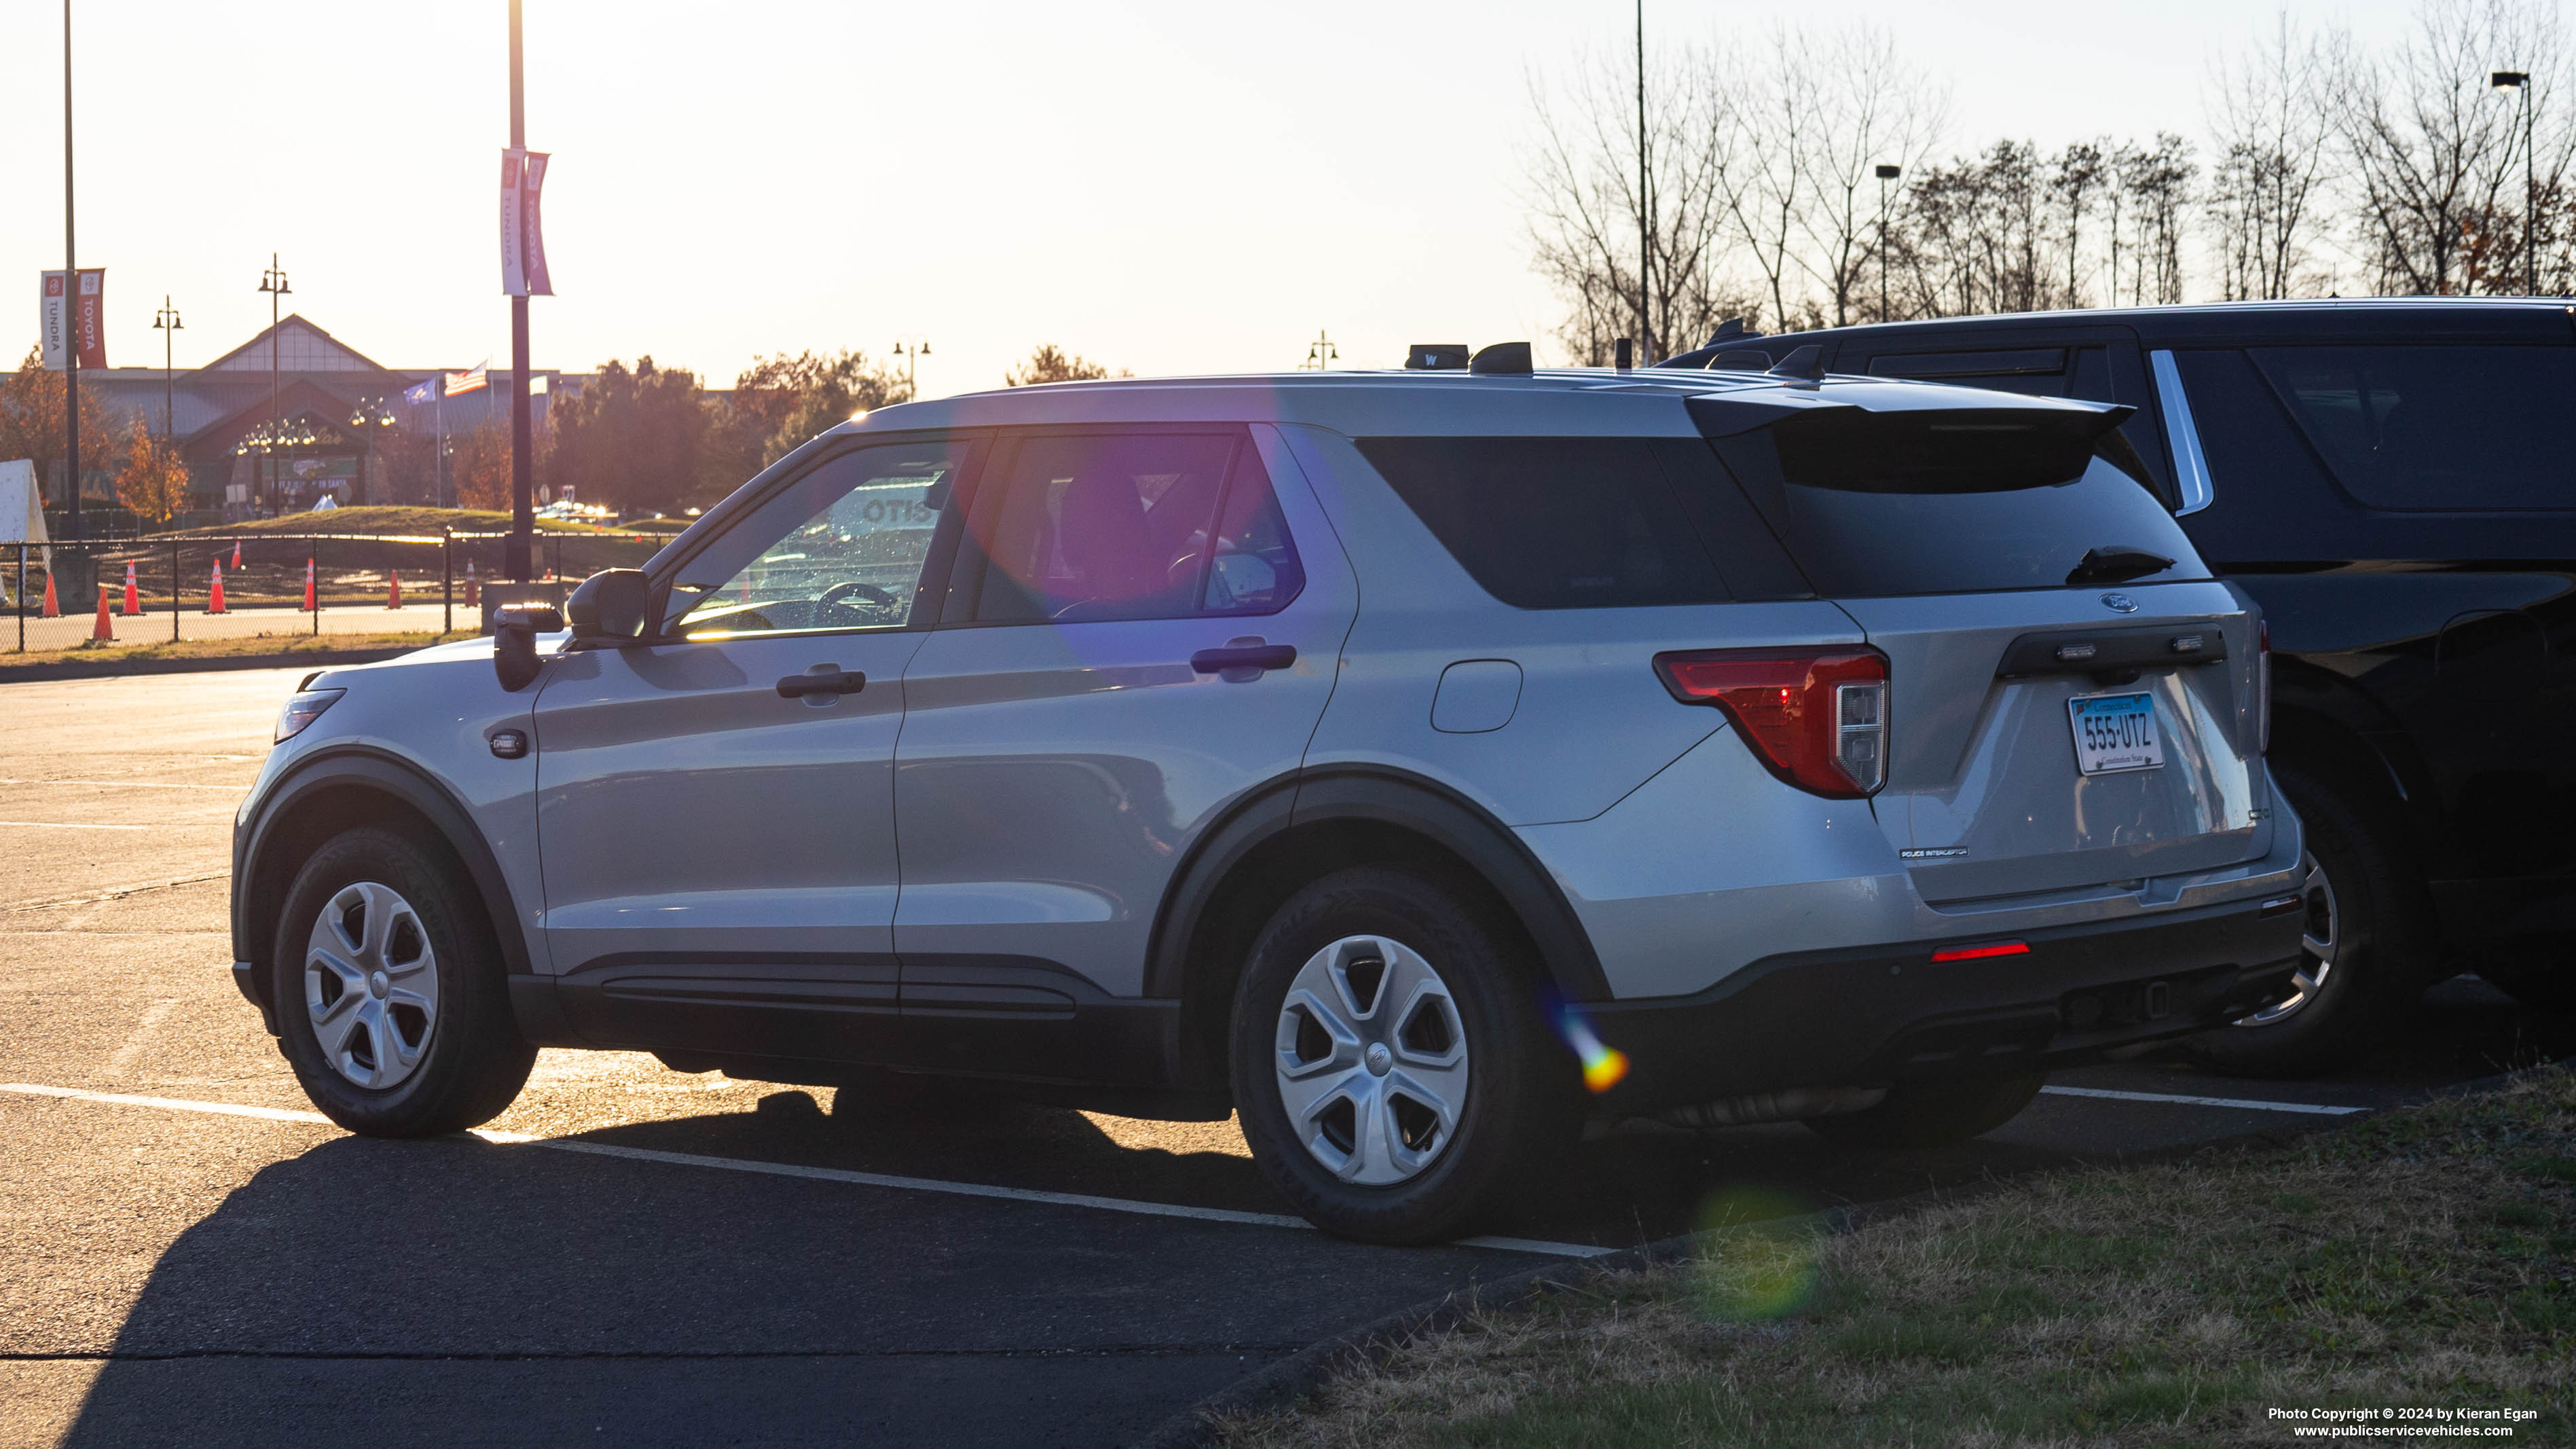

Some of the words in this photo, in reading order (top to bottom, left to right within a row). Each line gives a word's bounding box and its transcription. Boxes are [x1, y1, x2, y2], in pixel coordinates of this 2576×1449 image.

[529, 195, 538, 269] TOYOTA
[50, 301, 60, 351] TUNDRA
[85, 299, 94, 350] TOYOTA
